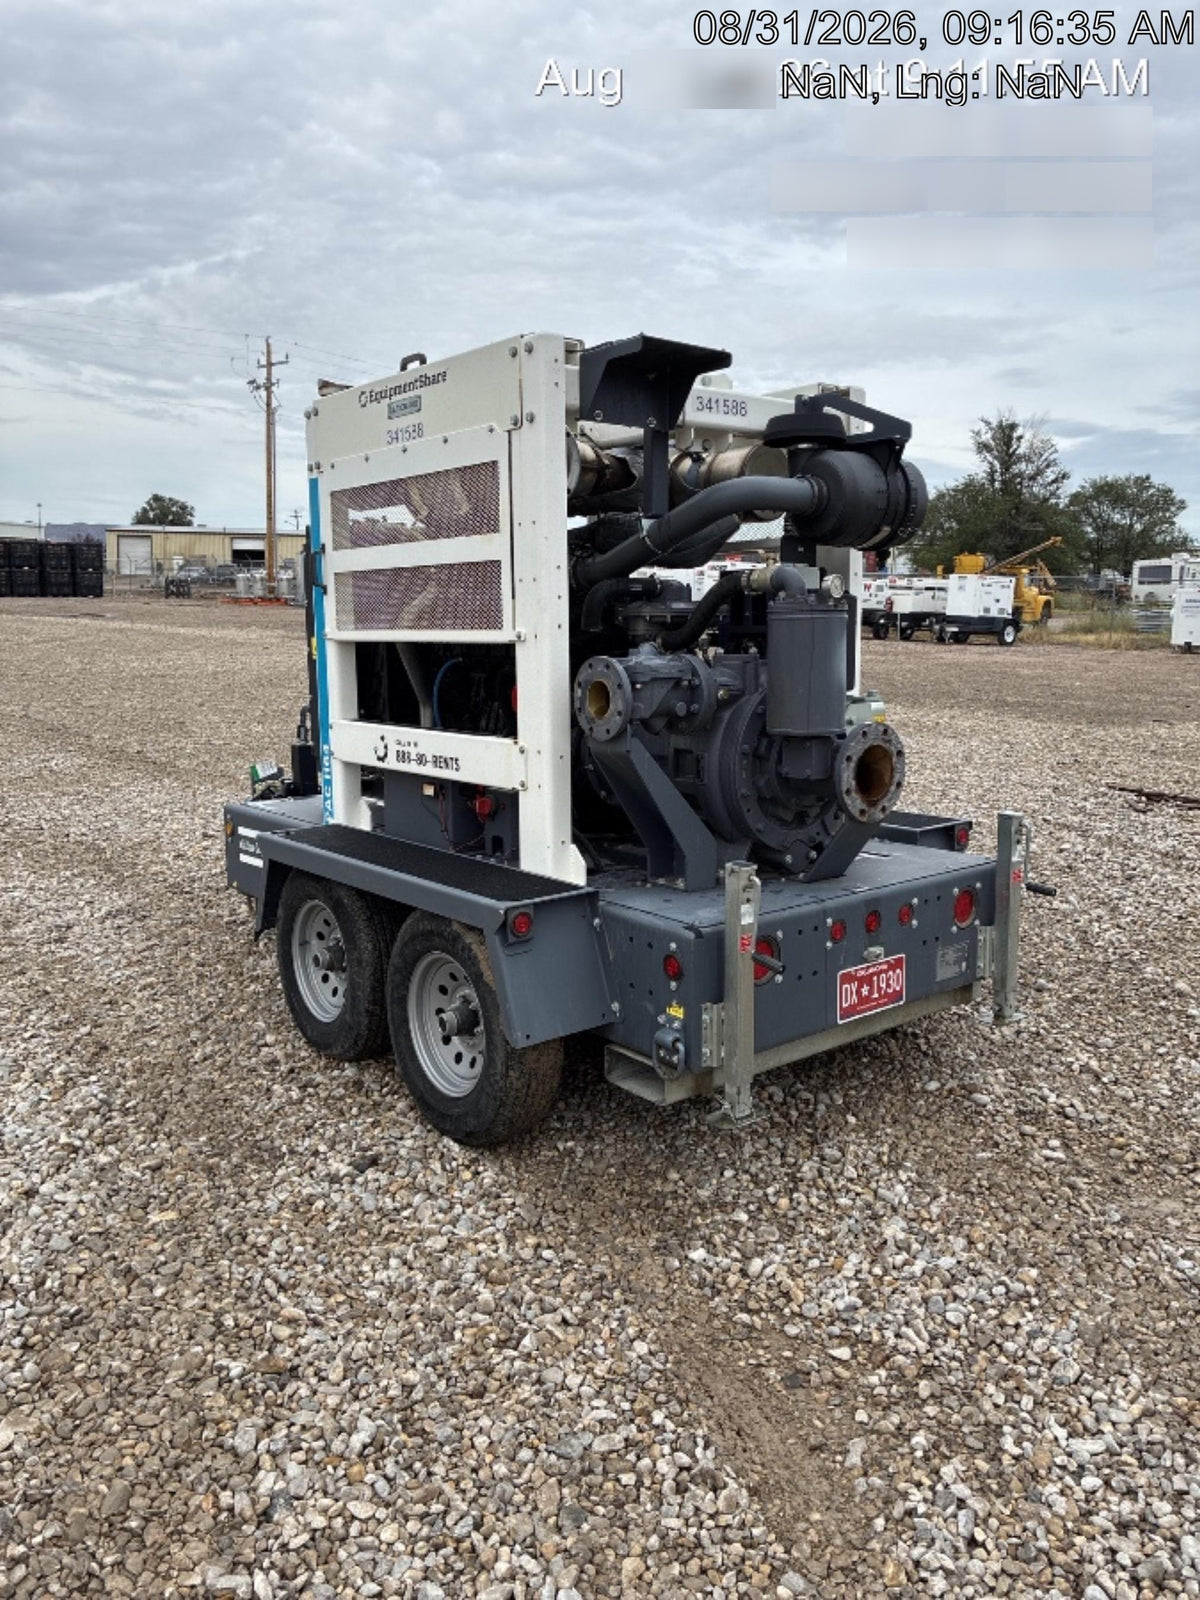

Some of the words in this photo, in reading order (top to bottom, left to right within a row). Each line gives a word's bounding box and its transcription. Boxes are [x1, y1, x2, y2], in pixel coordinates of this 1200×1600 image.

[369, 370, 447, 404] EquipmentShare
[842, 981, 858, 1008] DX
[871, 968, 903, 999] 1930
